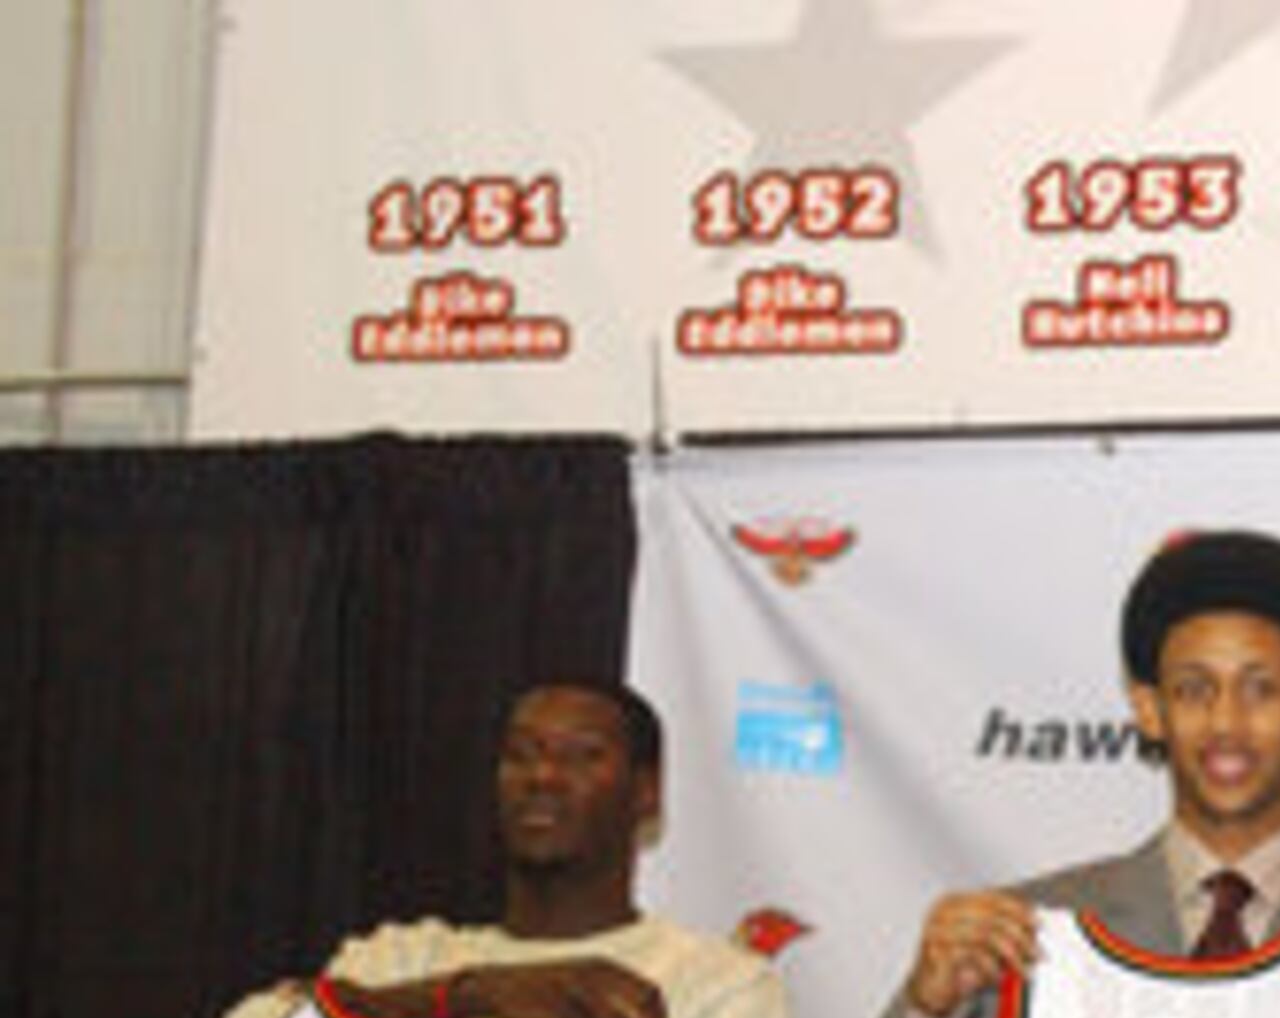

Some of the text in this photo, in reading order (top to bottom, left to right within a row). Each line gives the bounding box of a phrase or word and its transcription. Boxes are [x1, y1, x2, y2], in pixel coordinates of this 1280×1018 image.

[371, 175, 564, 248] 1951
[695, 170, 897, 243] 1952
[1029, 159, 1238, 229] 1953
